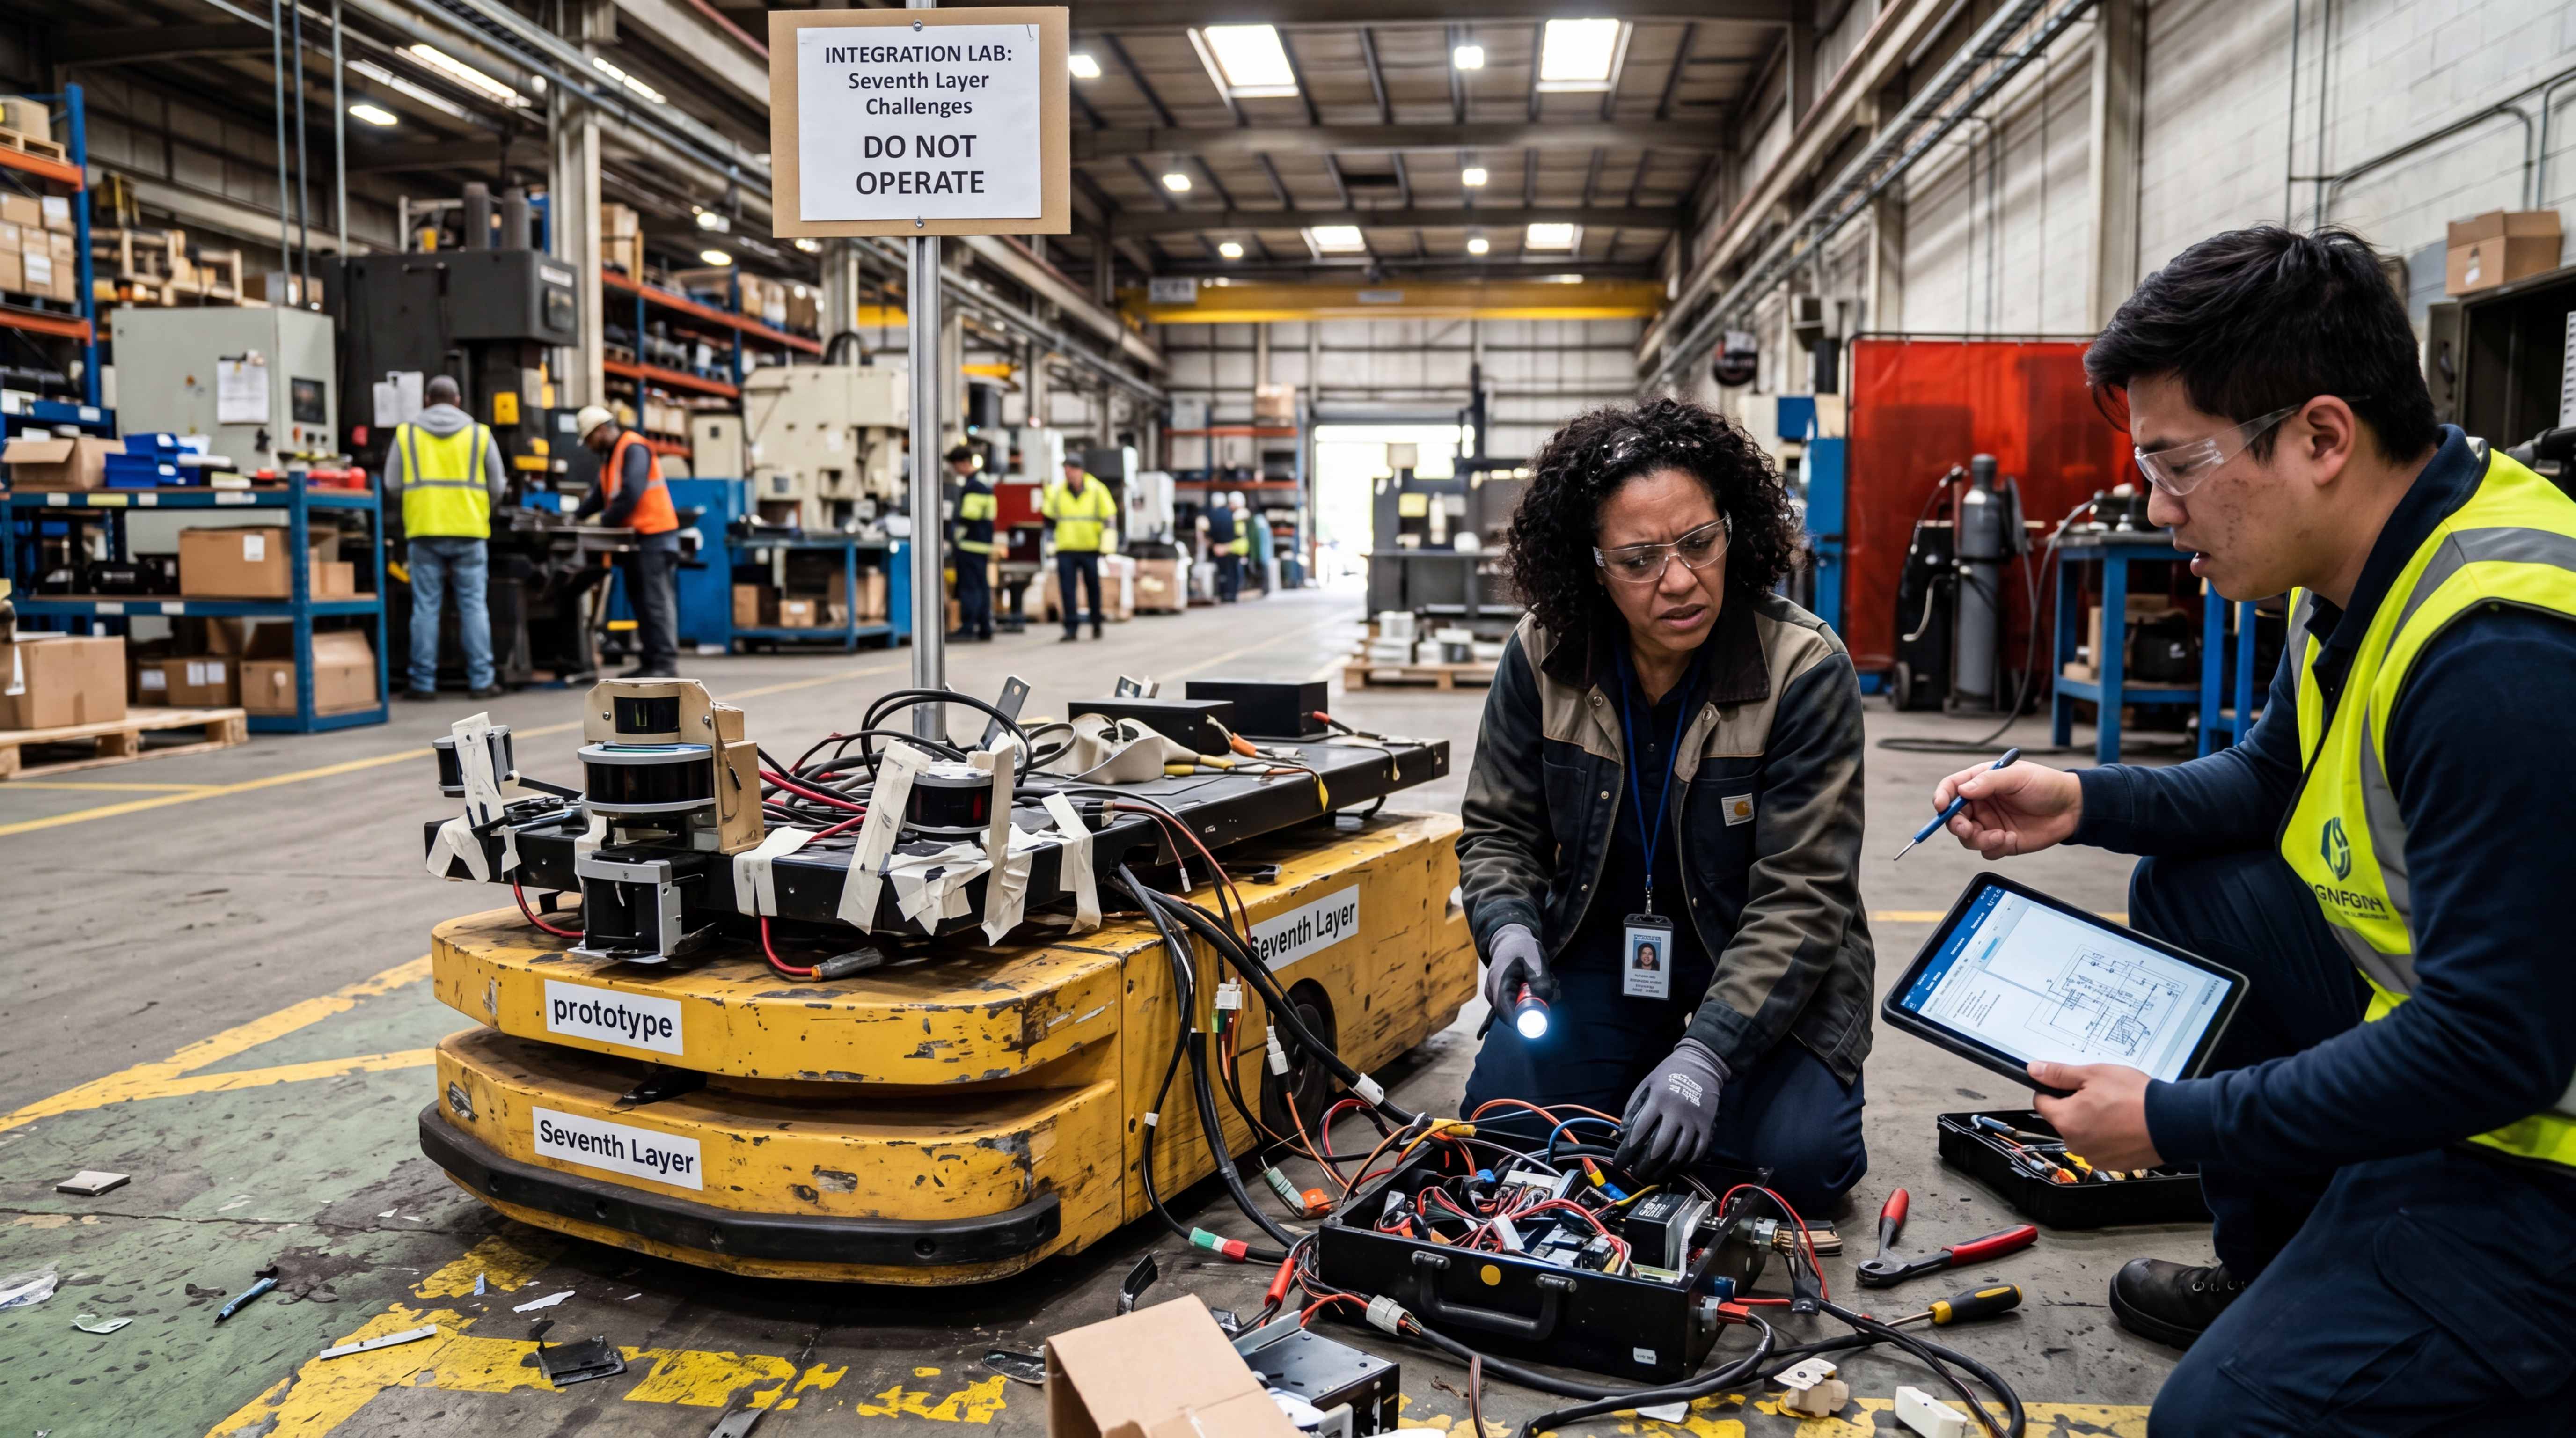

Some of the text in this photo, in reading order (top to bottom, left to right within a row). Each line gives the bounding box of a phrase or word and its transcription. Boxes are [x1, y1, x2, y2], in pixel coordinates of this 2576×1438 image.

[826, 45, 1012, 63] INTEGRATION LAB:
[849, 71, 989, 92] Seventh Layer
[866, 97, 973, 118] Challenges
[864, 135, 977, 159] DO NOT
[856, 171, 985, 195] OPERATE
[1251, 903, 1355, 961] Seventh Layer
[554, 999, 673, 1042] prototype
[540, 1120, 694, 1174] Seventh Layer
